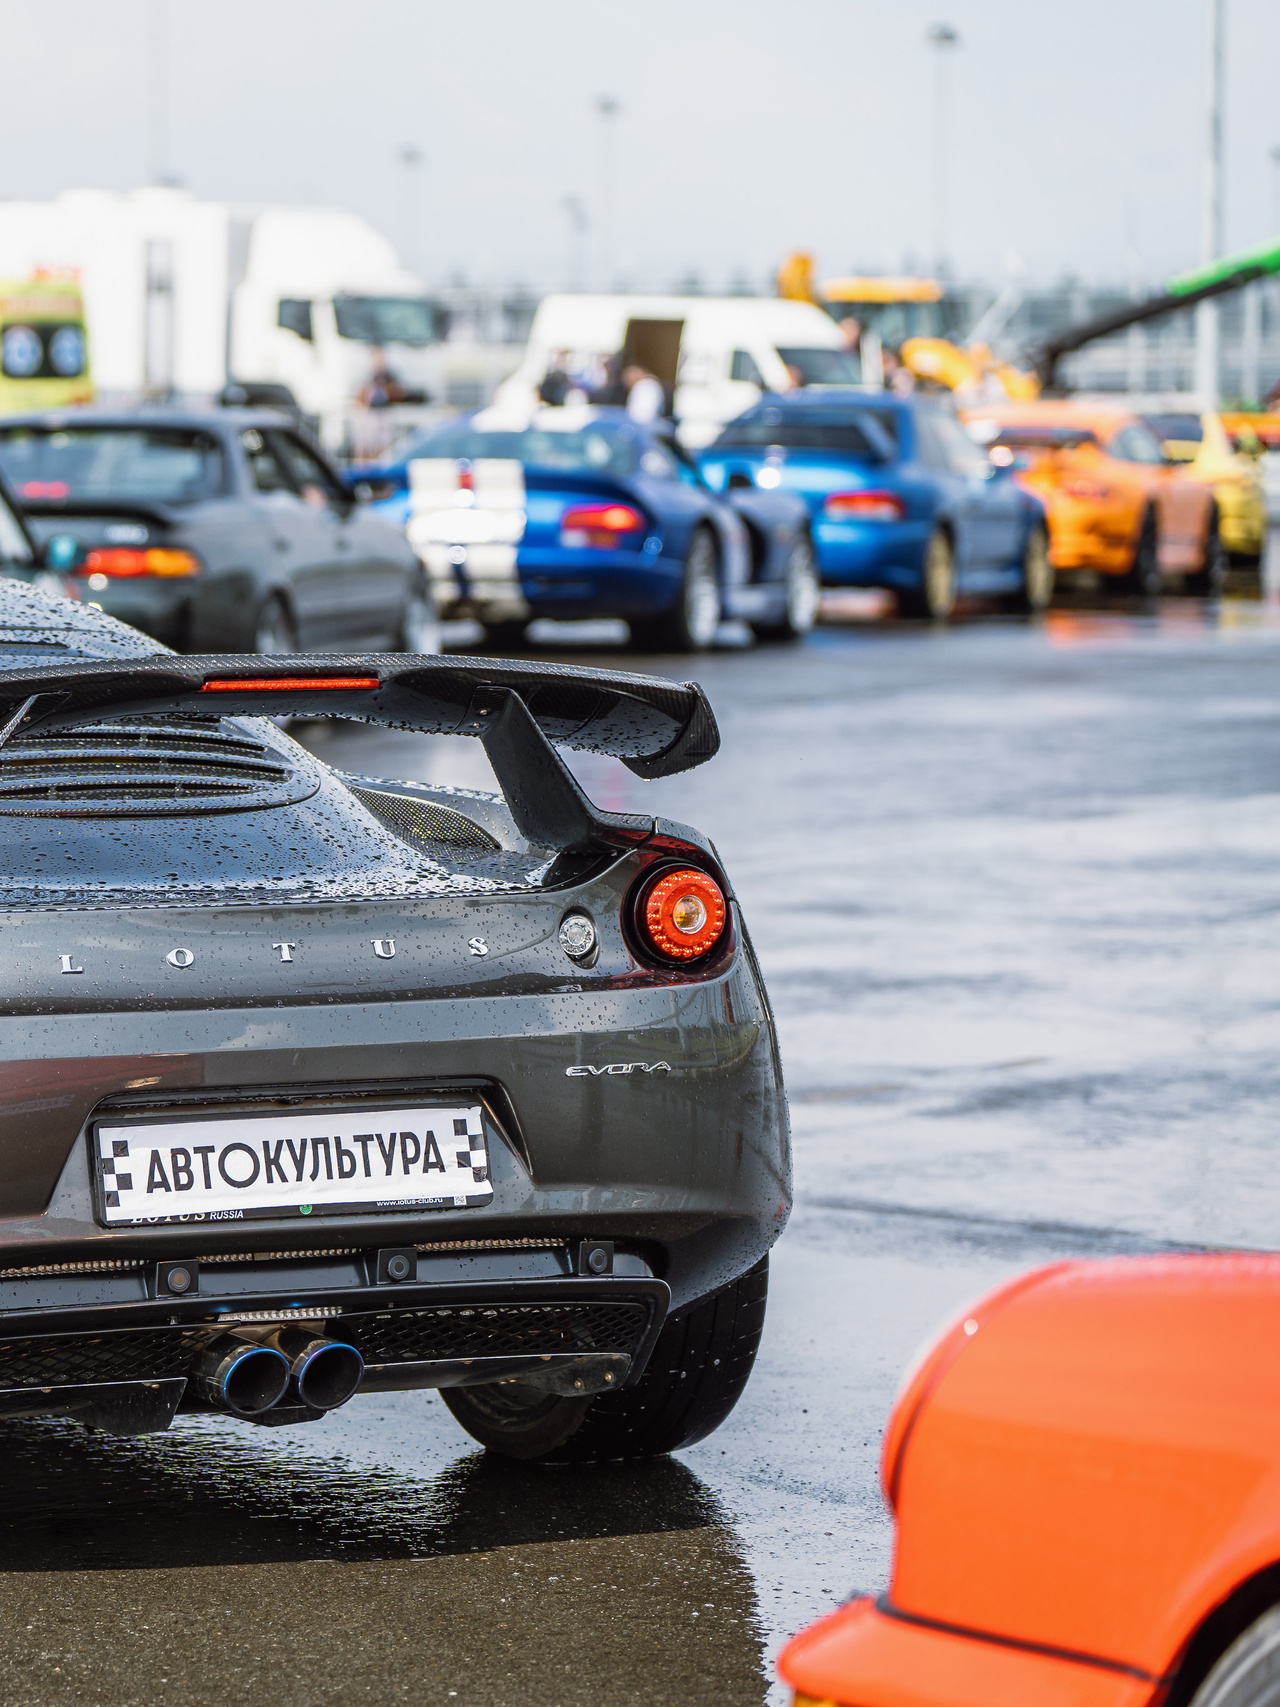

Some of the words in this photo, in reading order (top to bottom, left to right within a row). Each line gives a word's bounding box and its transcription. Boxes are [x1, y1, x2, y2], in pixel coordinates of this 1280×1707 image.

[58, 936, 489, 974] LOTUS
[565, 1061, 672, 1077] EVORA
[146, 1130, 446, 1193] АВТОКУЛЬТУРА
[209, 1209, 244, 1220] RUSSIA
